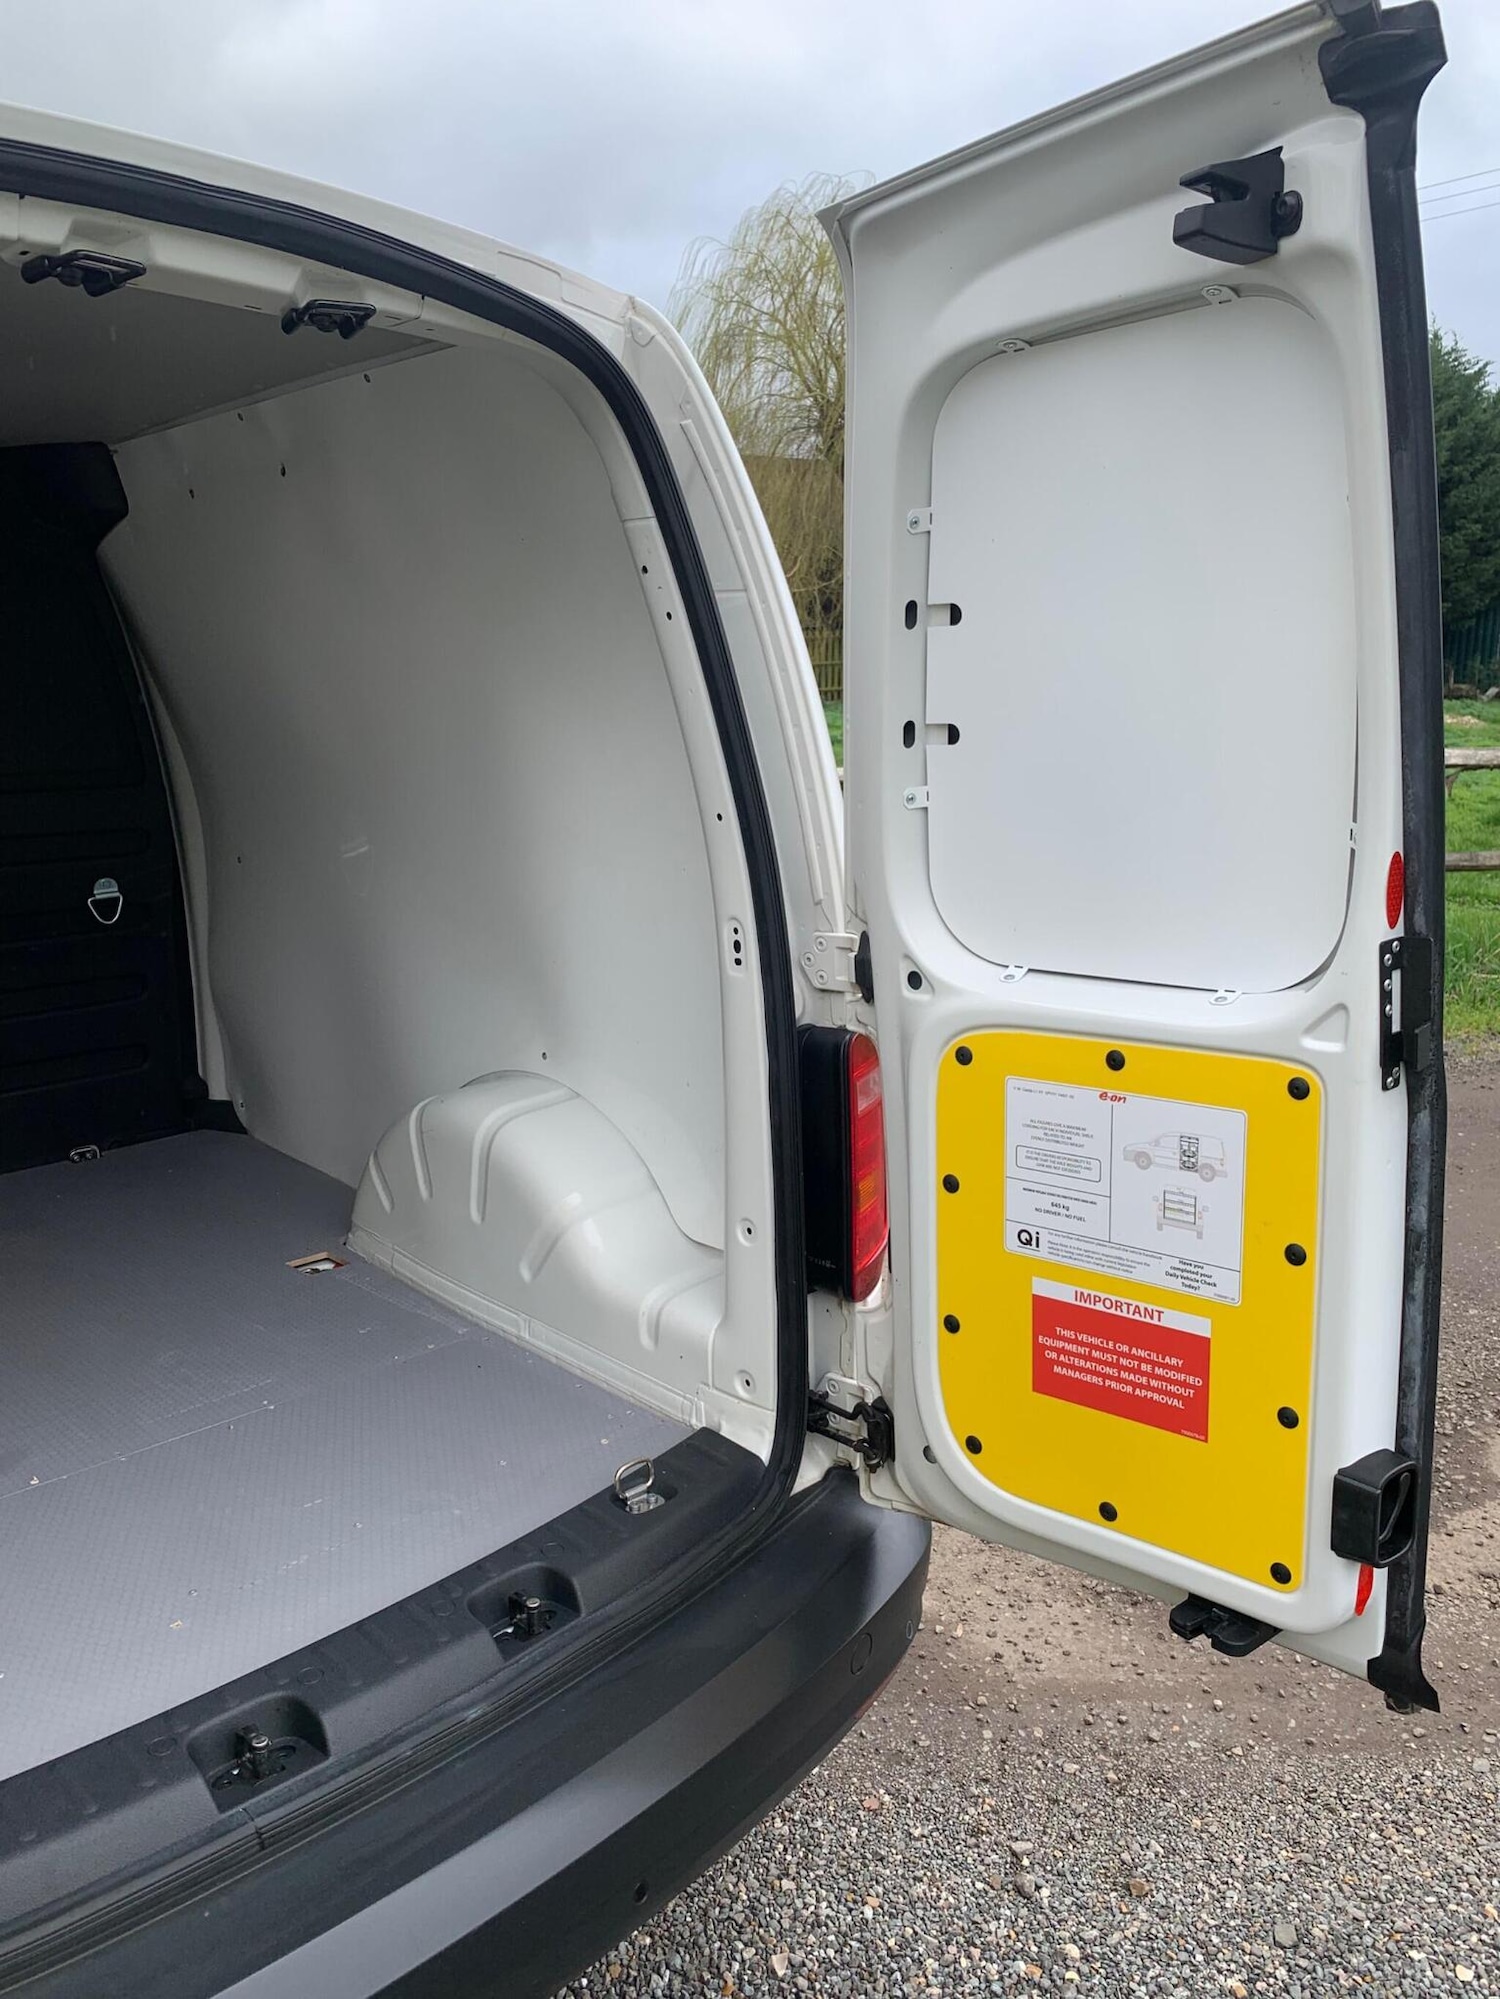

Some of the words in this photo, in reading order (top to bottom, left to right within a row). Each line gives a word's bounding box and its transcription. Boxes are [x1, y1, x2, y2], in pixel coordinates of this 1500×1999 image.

[1043, 1209, 1061, 1217] DRIVER
[1063, 1204, 1070, 1212] kg
[1017, 1228, 1040, 1249] Qi
[1165, 1271, 1179, 1280] Daily
[1180, 1274, 1199, 1283] Vehicle
[1200, 1279, 1217, 1287] Check
[1170, 1265, 1199, 1276] completed
[1182, 1282, 1200, 1292] Today?
[1075, 1290, 1164, 1324] IMPORTANT
[1055, 1327, 1075, 1340] THIS
[1077, 1332, 1114, 1350] VEHICLE
[1116, 1342, 1129, 1354] OR
[1131, 1346, 1183, 1369] ANCILLARY
[1039, 1335, 1090, 1357] EQUIPMENT
[1092, 1349, 1118, 1365] MUST
[1120, 1357, 1138, 1370] NOT
[1141, 1362, 1153, 1374] BE
[1155, 1366, 1203, 1387] MODIFIED
[1045, 1349, 1057, 1361] OR
[1060, 1353, 1118, 1378] ALTERATIONS
[1120, 1370, 1148, 1386] MADE
[1150, 1378, 1195, 1399] WITHOUT
[1054, 1364, 1103, 1386] MANAGERS
[1105, 1379, 1133, 1395] PRIOR
[1135, 1387, 1185, 1409] APPROVAL
